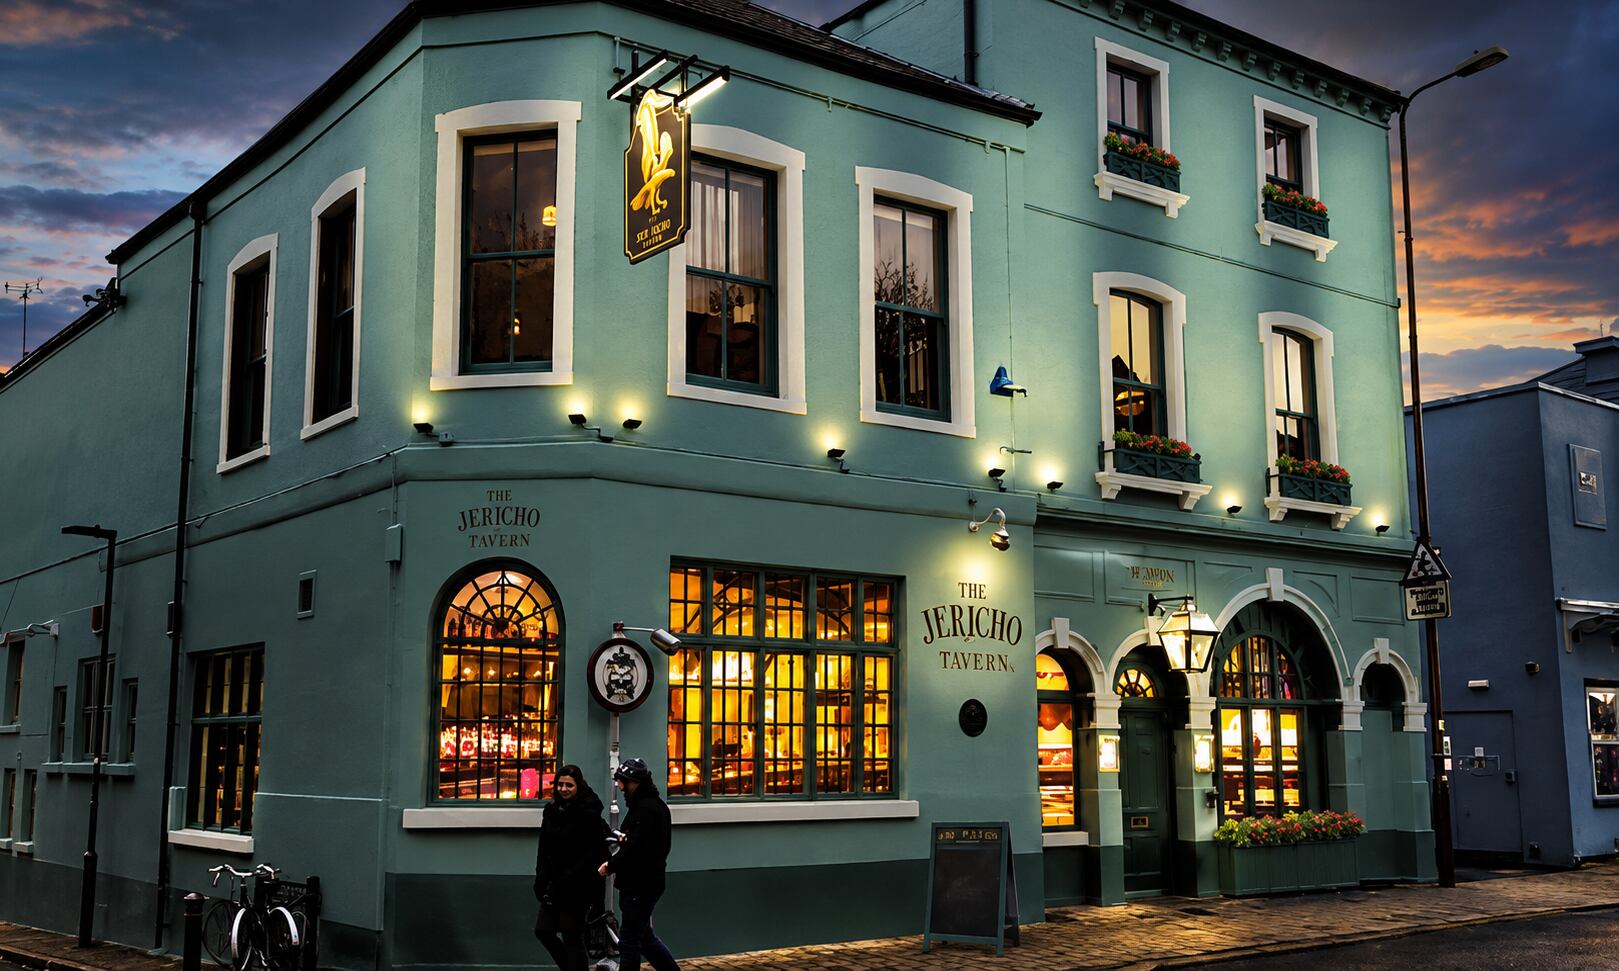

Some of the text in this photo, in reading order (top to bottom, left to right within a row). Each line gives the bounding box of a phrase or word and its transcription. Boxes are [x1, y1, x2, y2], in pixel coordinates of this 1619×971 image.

[486, 489, 512, 502] THE
[458, 506, 540, 532] JERICHO
[469, 533, 531, 548] TAVERN
[958, 582, 987, 600] THE
[920, 604, 1022, 646] JERICHO
[939, 651, 1009, 672] TAVERN
